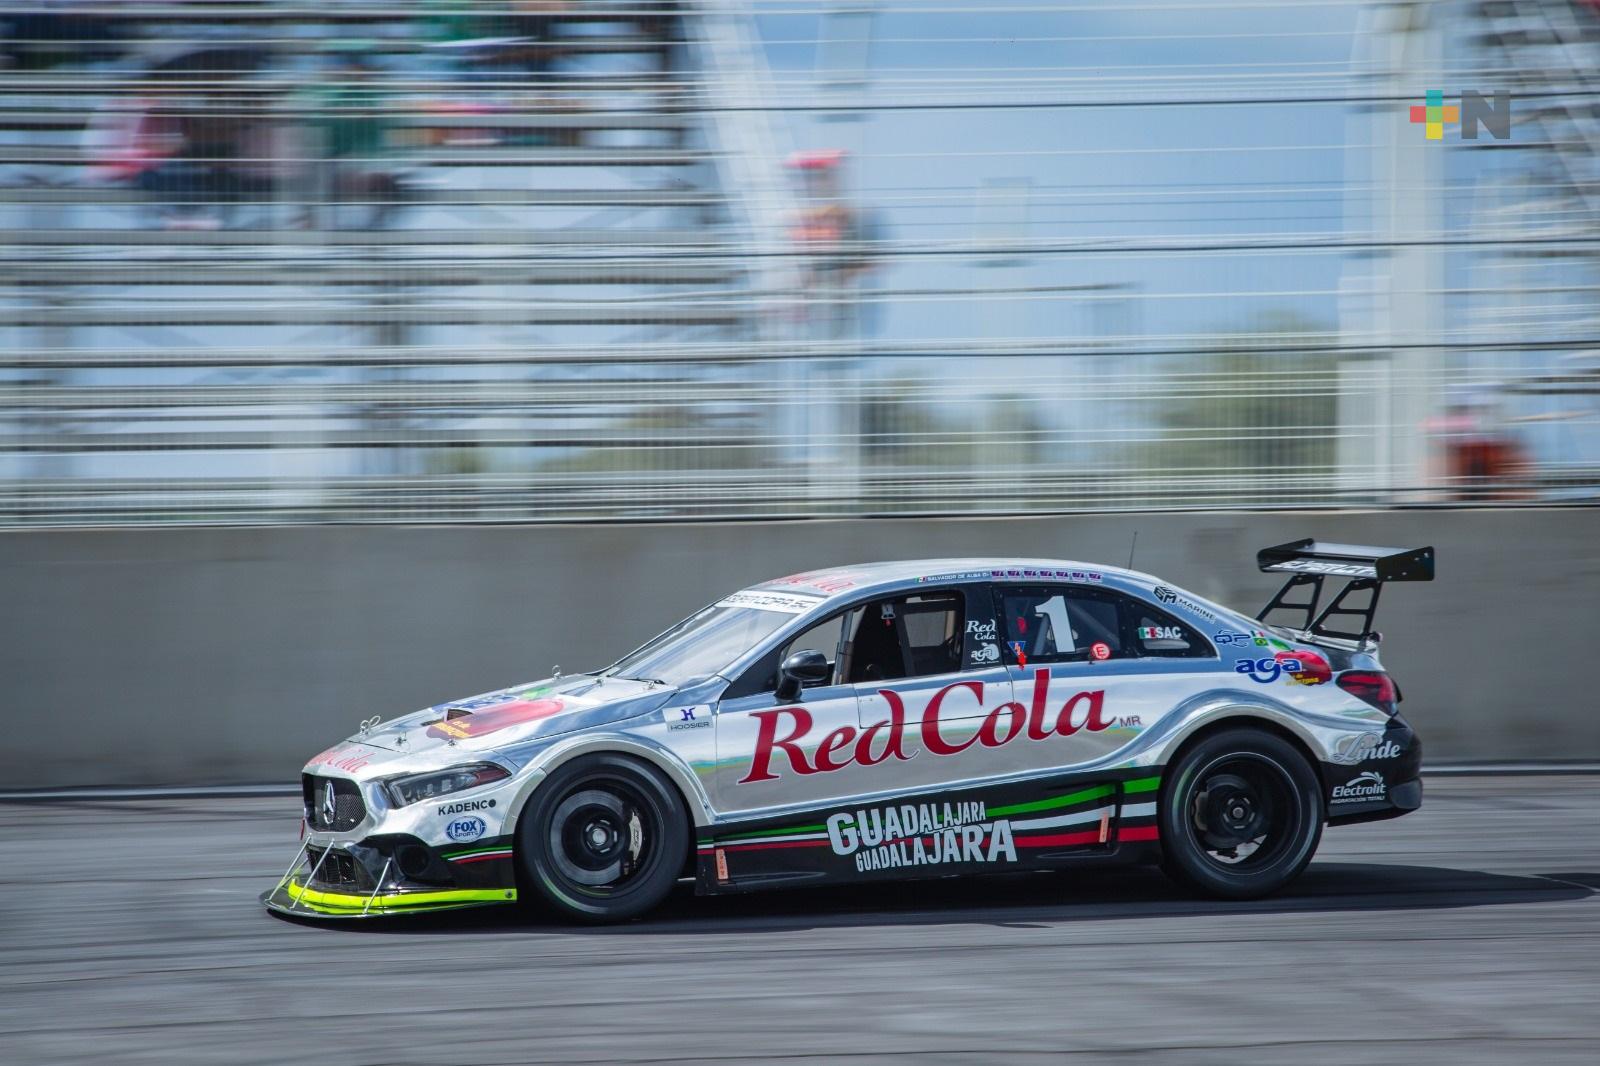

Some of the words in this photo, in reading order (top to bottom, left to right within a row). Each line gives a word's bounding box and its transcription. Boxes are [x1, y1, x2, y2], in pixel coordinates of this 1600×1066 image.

[1179, 598, 1215, 620] MARINE
[966, 618, 997, 633] Red
[1034, 595, 1076, 653] 1
[1155, 626, 1182, 639] SAC
[974, 632, 997, 640] Cola
[1235, 658, 1300, 684] aga
[670, 721, 710, 731] HOOSIER
[737, 689, 919, 785] Red
[921, 668, 1118, 756] Cola
[1119, 715, 1142, 728] MR
[1332, 731, 1401, 763] Linde
[1332, 783, 1386, 798] Electrolit
[454, 820, 477, 833] FOX
[454, 830, 479, 838] SPORTS
[826, 800, 987, 856] GUADALAJARA
[855, 819, 1018, 872] GUADALAJARA
